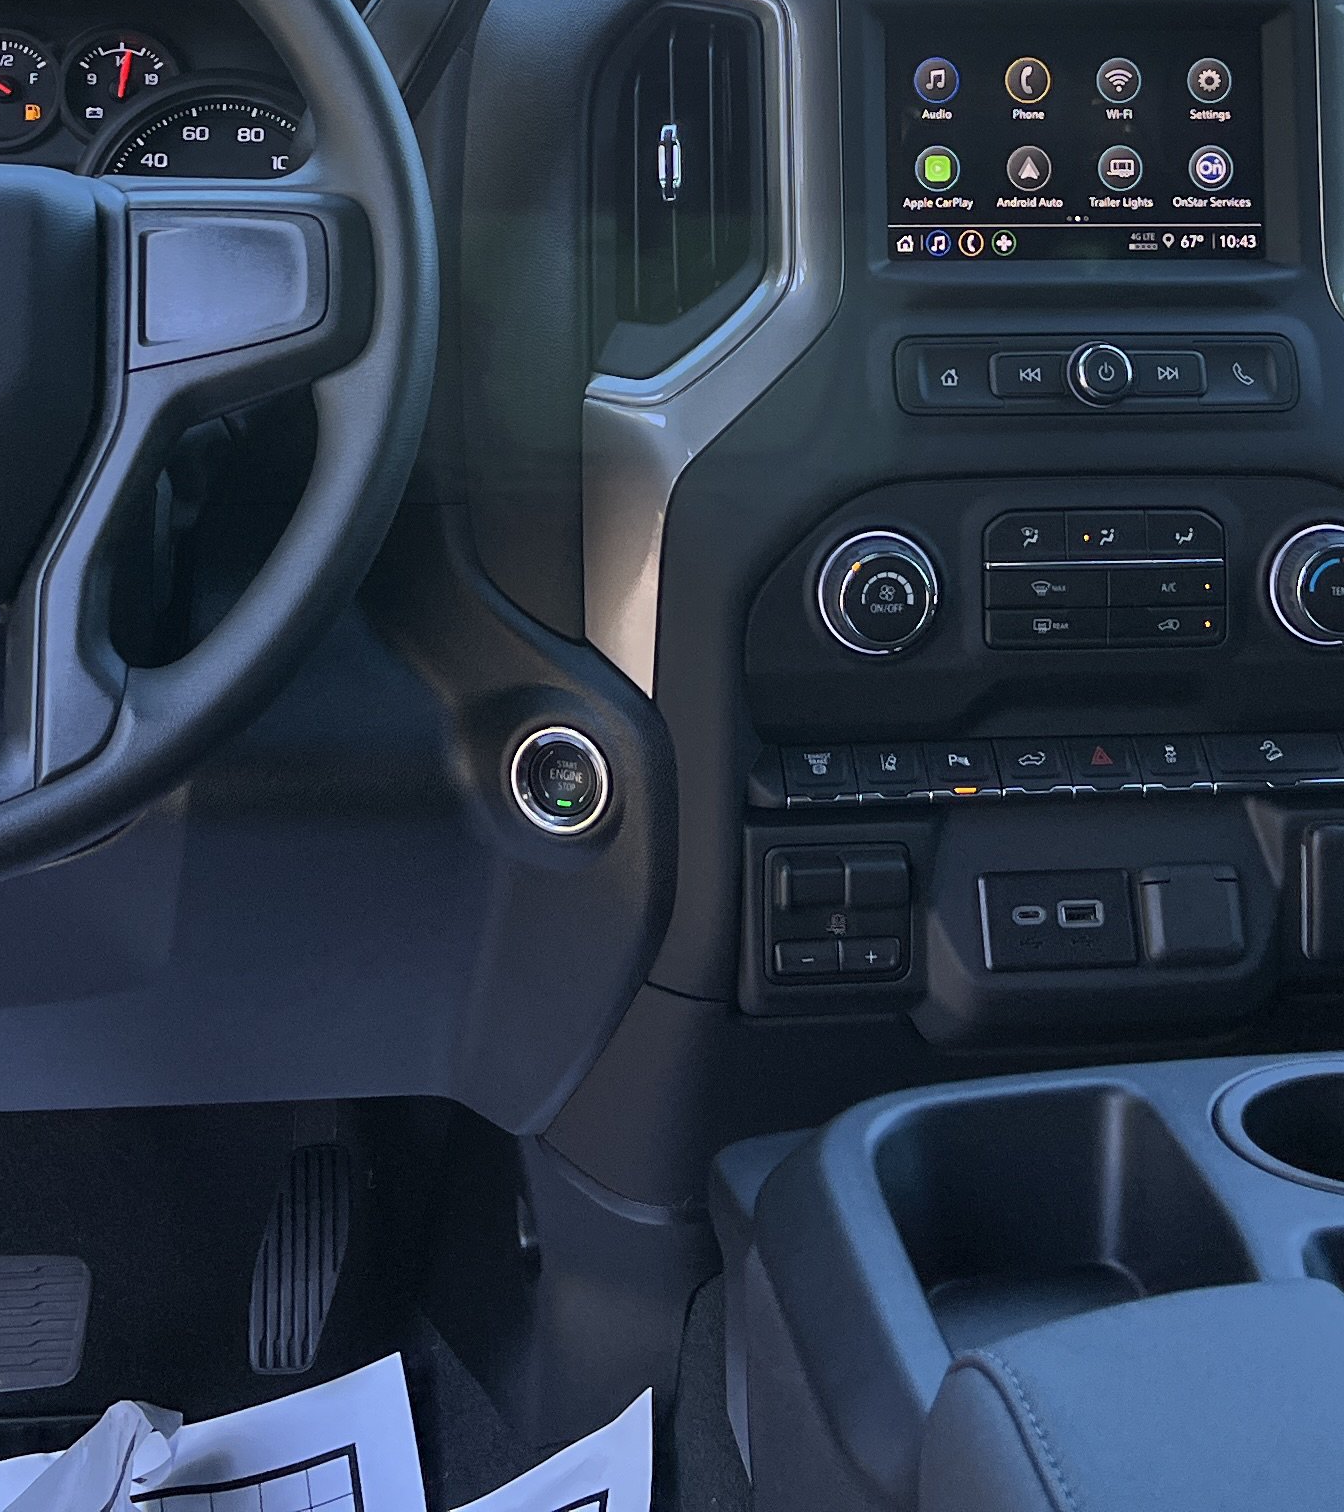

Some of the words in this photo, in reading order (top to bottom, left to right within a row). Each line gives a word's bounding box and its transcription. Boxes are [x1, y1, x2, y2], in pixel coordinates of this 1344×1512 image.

[29, 72, 39, 85] F
[86, 73, 97, 85] 9
[144, 73, 159, 85] 19
[921, 108, 953, 120] Audio
[1012, 108, 1045, 120] Phone
[1106, 108, 1133, 120] Wi-Fi
[1189, 108, 1232, 123] Settings
[182, 126, 210, 142] 60
[237, 127, 265, 143] 80
[140, 153, 169, 168] 40
[903, 196, 934, 211] Apple
[935, 196, 974, 211] CarPlay
[996, 196, 1037, 209] Android
[1038, 196, 1064, 209] Auto
[1089, 196, 1121, 209] Trailer
[1122, 196, 1154, 211] Lights
[1172, 196, 1208, 209] OnStar
[1210, 196, 1252, 209] Services
[1130, 233, 1141, 241] 4G
[1142, 233, 1156, 241] LTE
[1219, 234, 1257, 249] 10:43
[1161, 581, 1177, 593] A/C
[869, 603, 905, 614] ON/OFF
[550, 769, 584, 784] ENGINE
[558, 782, 576, 791] STOP
